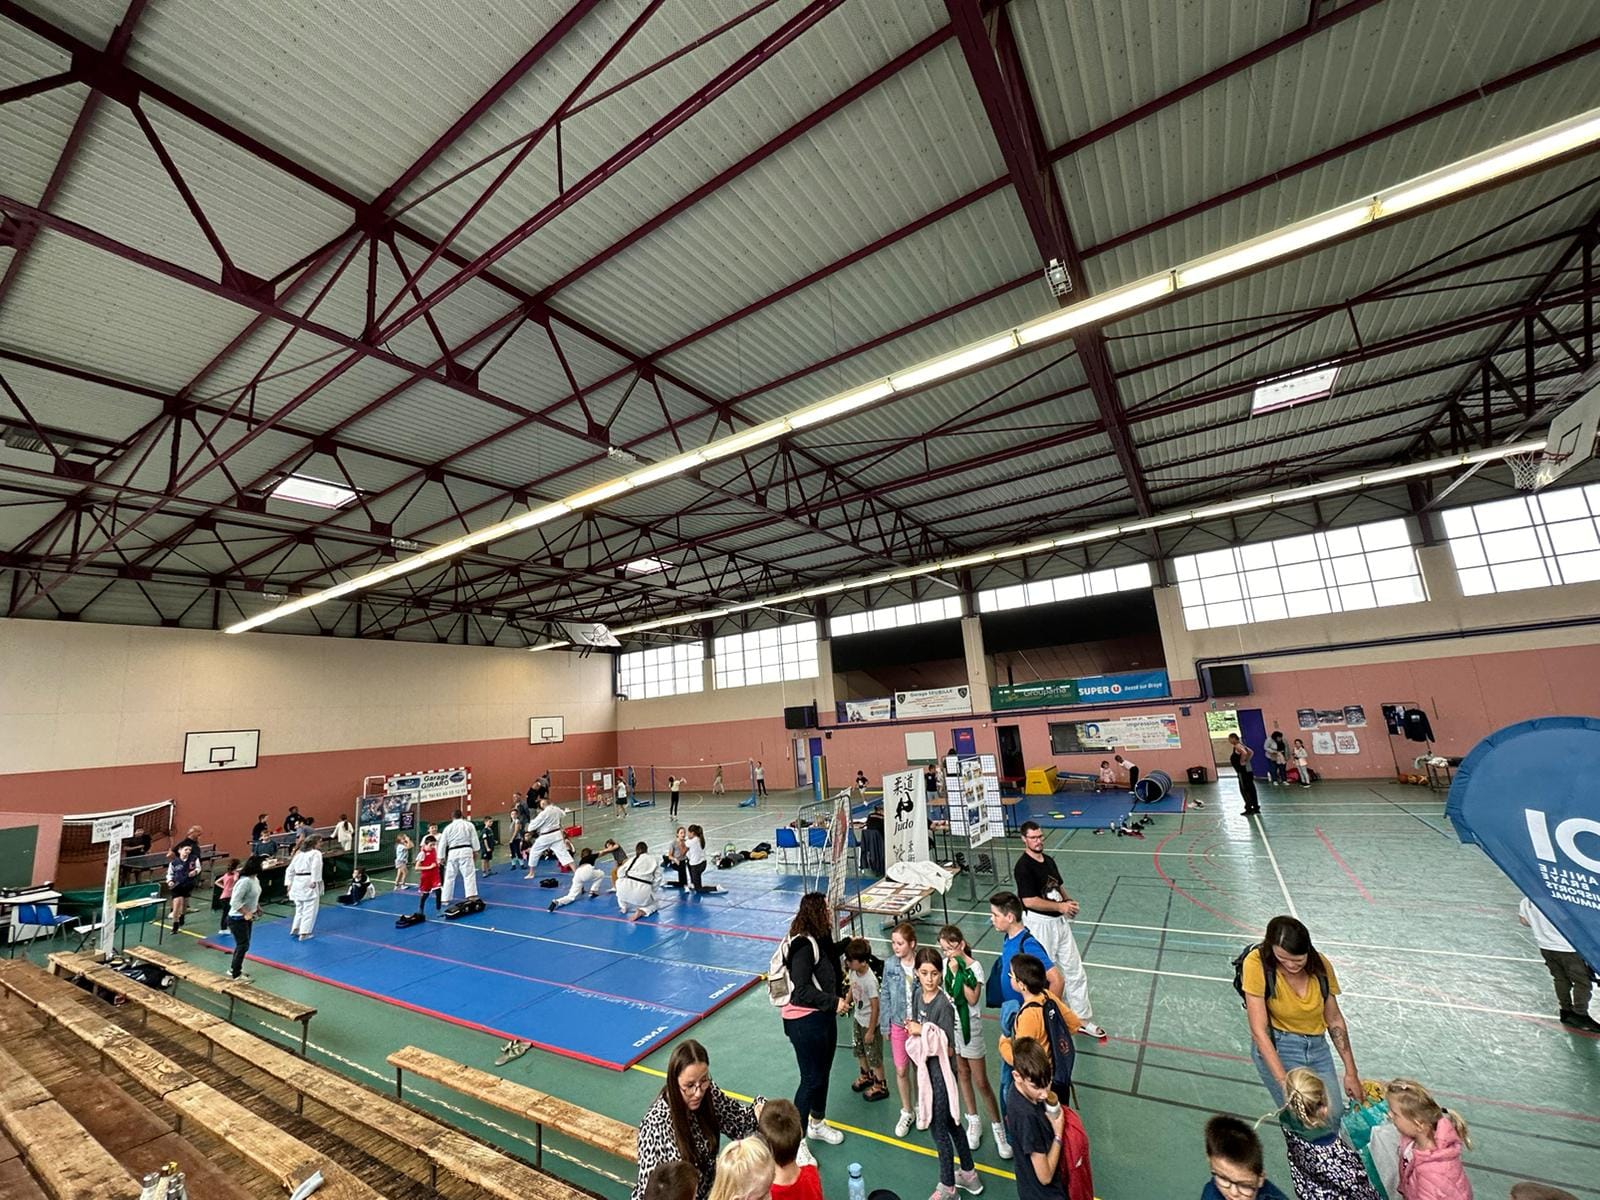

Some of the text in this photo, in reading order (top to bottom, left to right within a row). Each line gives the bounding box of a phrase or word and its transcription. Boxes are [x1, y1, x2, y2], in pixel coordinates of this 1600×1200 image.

[1078, 686, 1110, 696] SUPER
[424, 774, 449, 782] Garage
[708, 983, 737, 999] DIMA
[632, 1026, 668, 1048] DIMA
